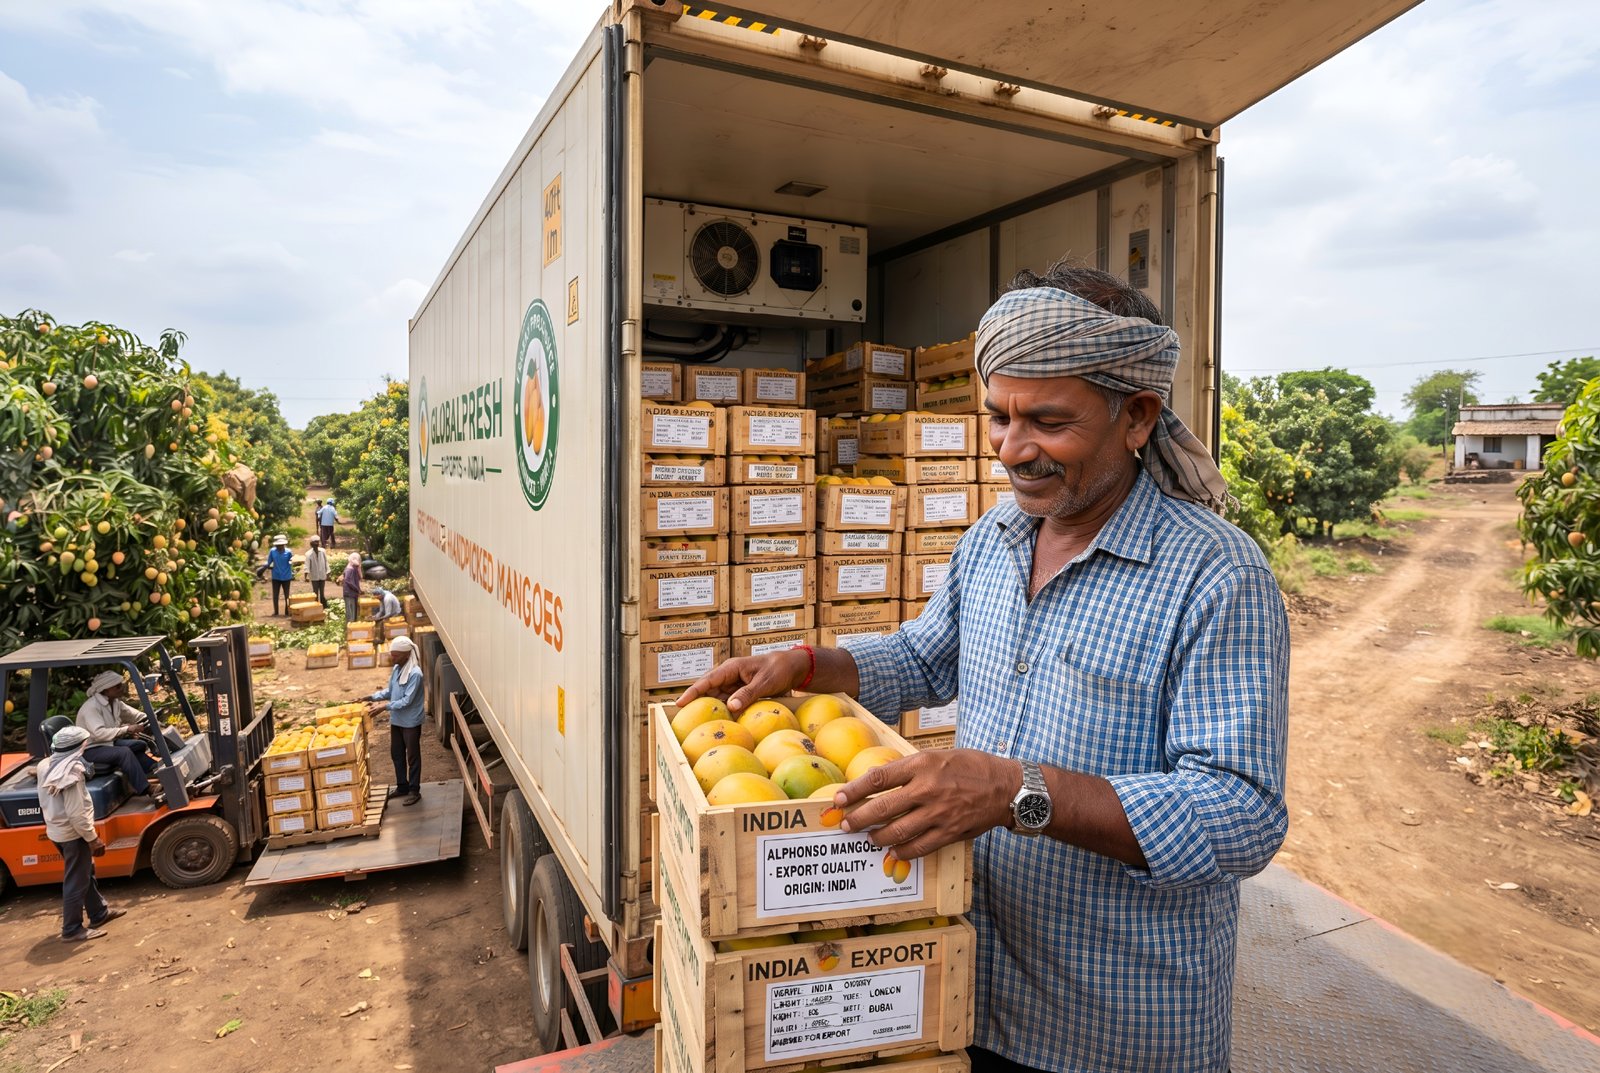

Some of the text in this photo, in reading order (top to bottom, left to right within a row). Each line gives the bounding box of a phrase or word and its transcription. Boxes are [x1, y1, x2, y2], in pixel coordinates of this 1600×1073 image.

[496, 558, 563, 653] MANGOES
[743, 808, 807, 833] INDIA
[767, 844, 827, 861] ALPHONSO
[776, 863, 819, 879] EXPORT
[821, 859, 867, 875] QUALITY
[784, 878, 857, 897] ORIGIN: INDIA
[749, 941, 937, 982] INDIA EXPORT
[811, 983, 833, 993] INDIA
